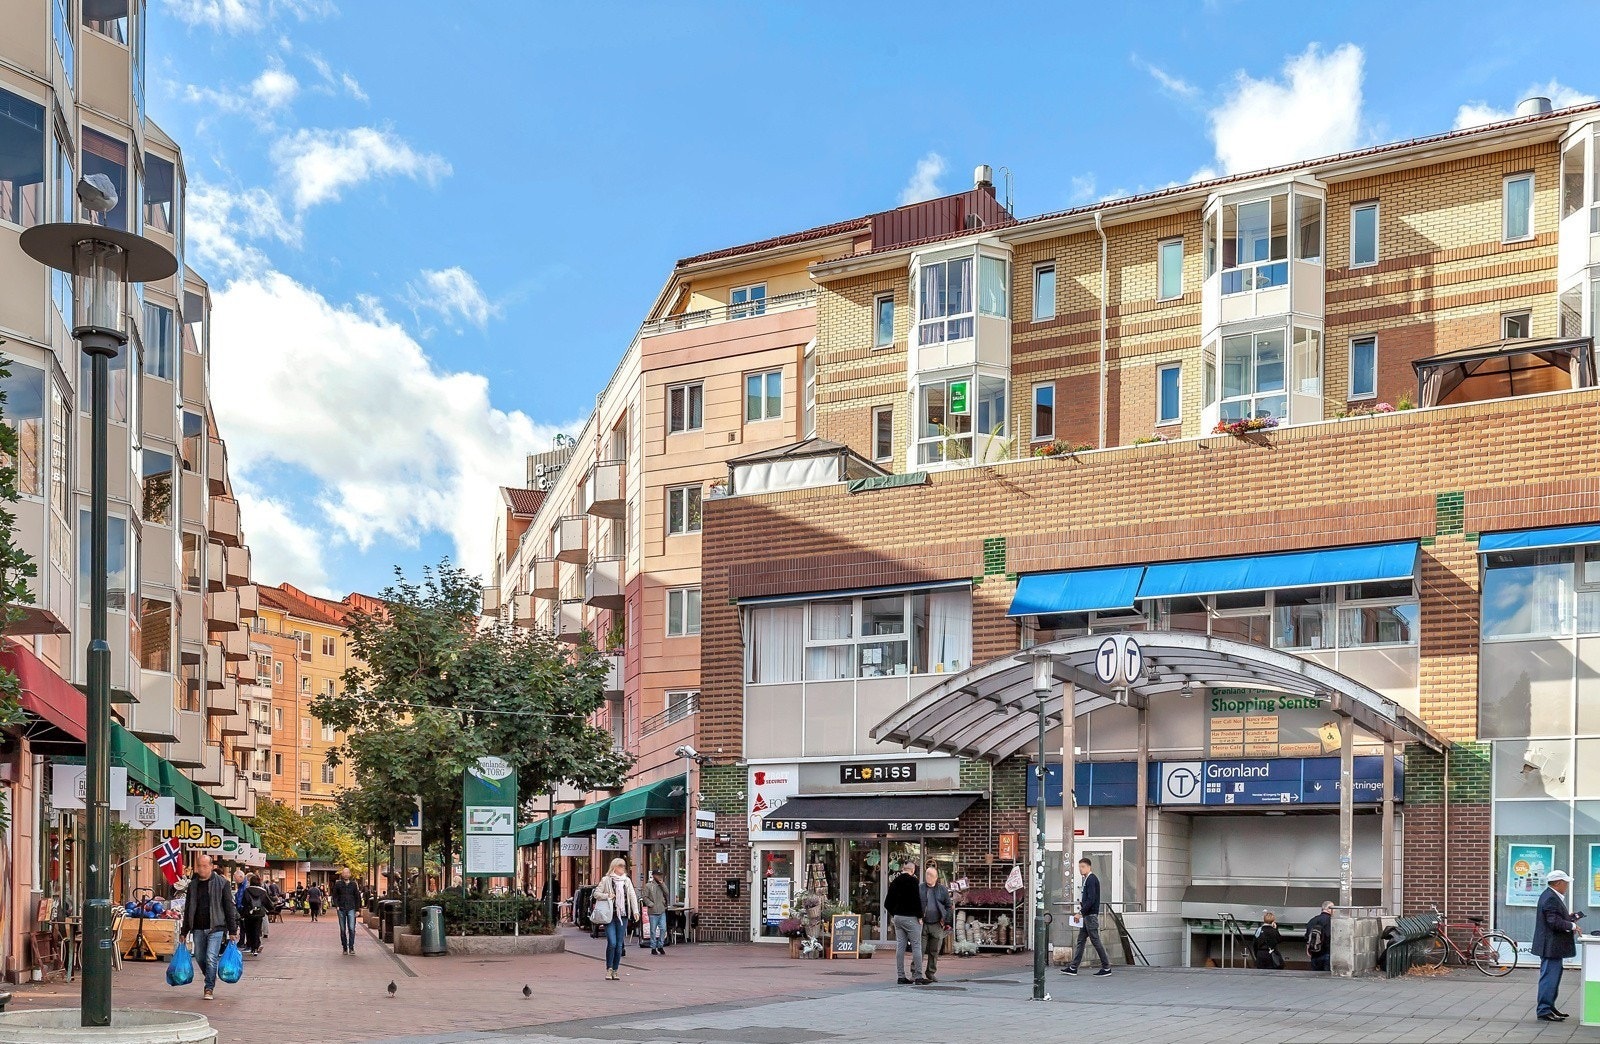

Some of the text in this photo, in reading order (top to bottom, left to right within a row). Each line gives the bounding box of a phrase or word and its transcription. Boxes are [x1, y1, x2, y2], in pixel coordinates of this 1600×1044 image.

[1212, 696, 1323, 713] Shopping Senter
[845, 766, 911, 780] FLORISS
[1207, 763, 1269, 777] Grønland
[765, 821, 808, 830] FLORISS
[901, 822, 913, 831] 22
[914, 822, 923, 831] 17
[938, 822, 950, 831] 50
